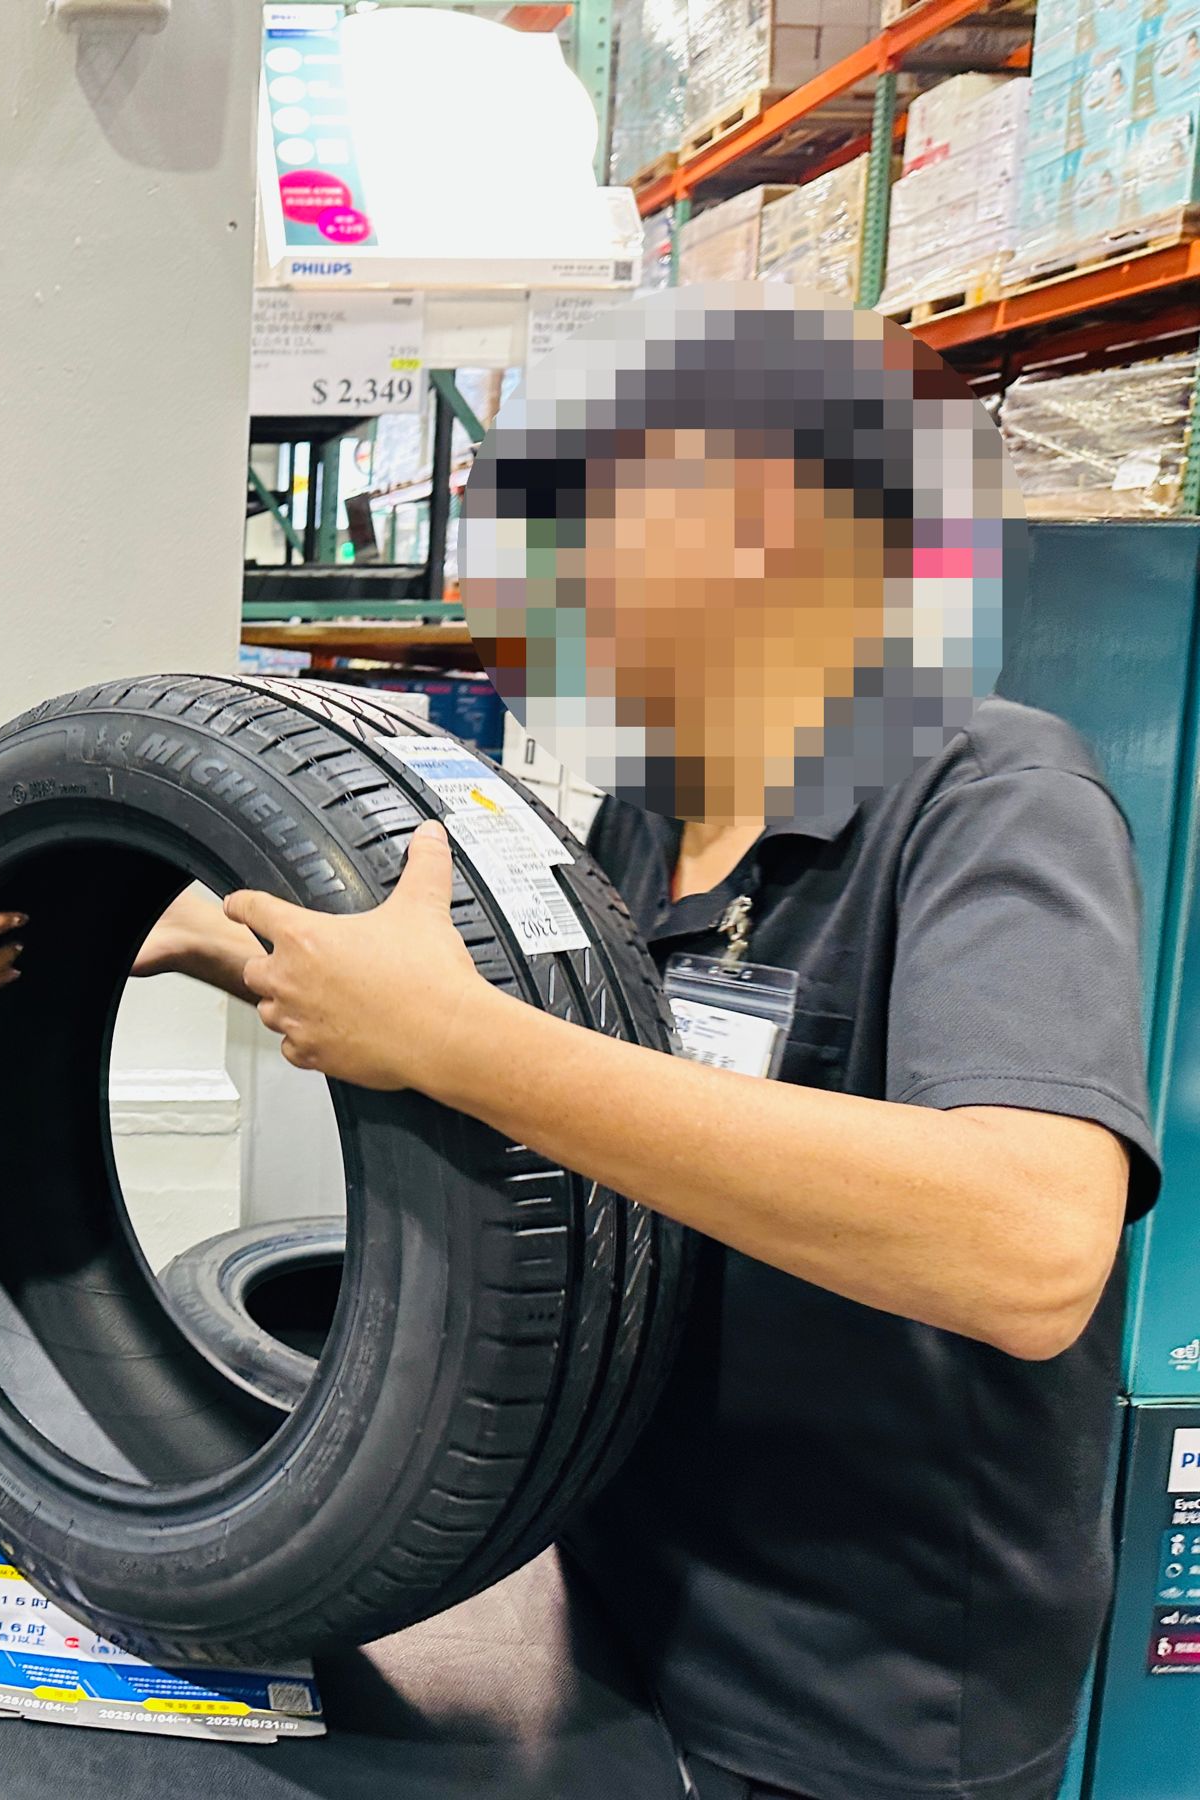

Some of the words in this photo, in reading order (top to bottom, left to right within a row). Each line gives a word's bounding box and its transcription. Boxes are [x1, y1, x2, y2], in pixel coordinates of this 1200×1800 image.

[291, 262, 352, 275] PHILIPS
[311, 377, 328, 405] $
[337, 377, 413, 409] 2,349
[134, 732, 347, 897] MICHELIN
